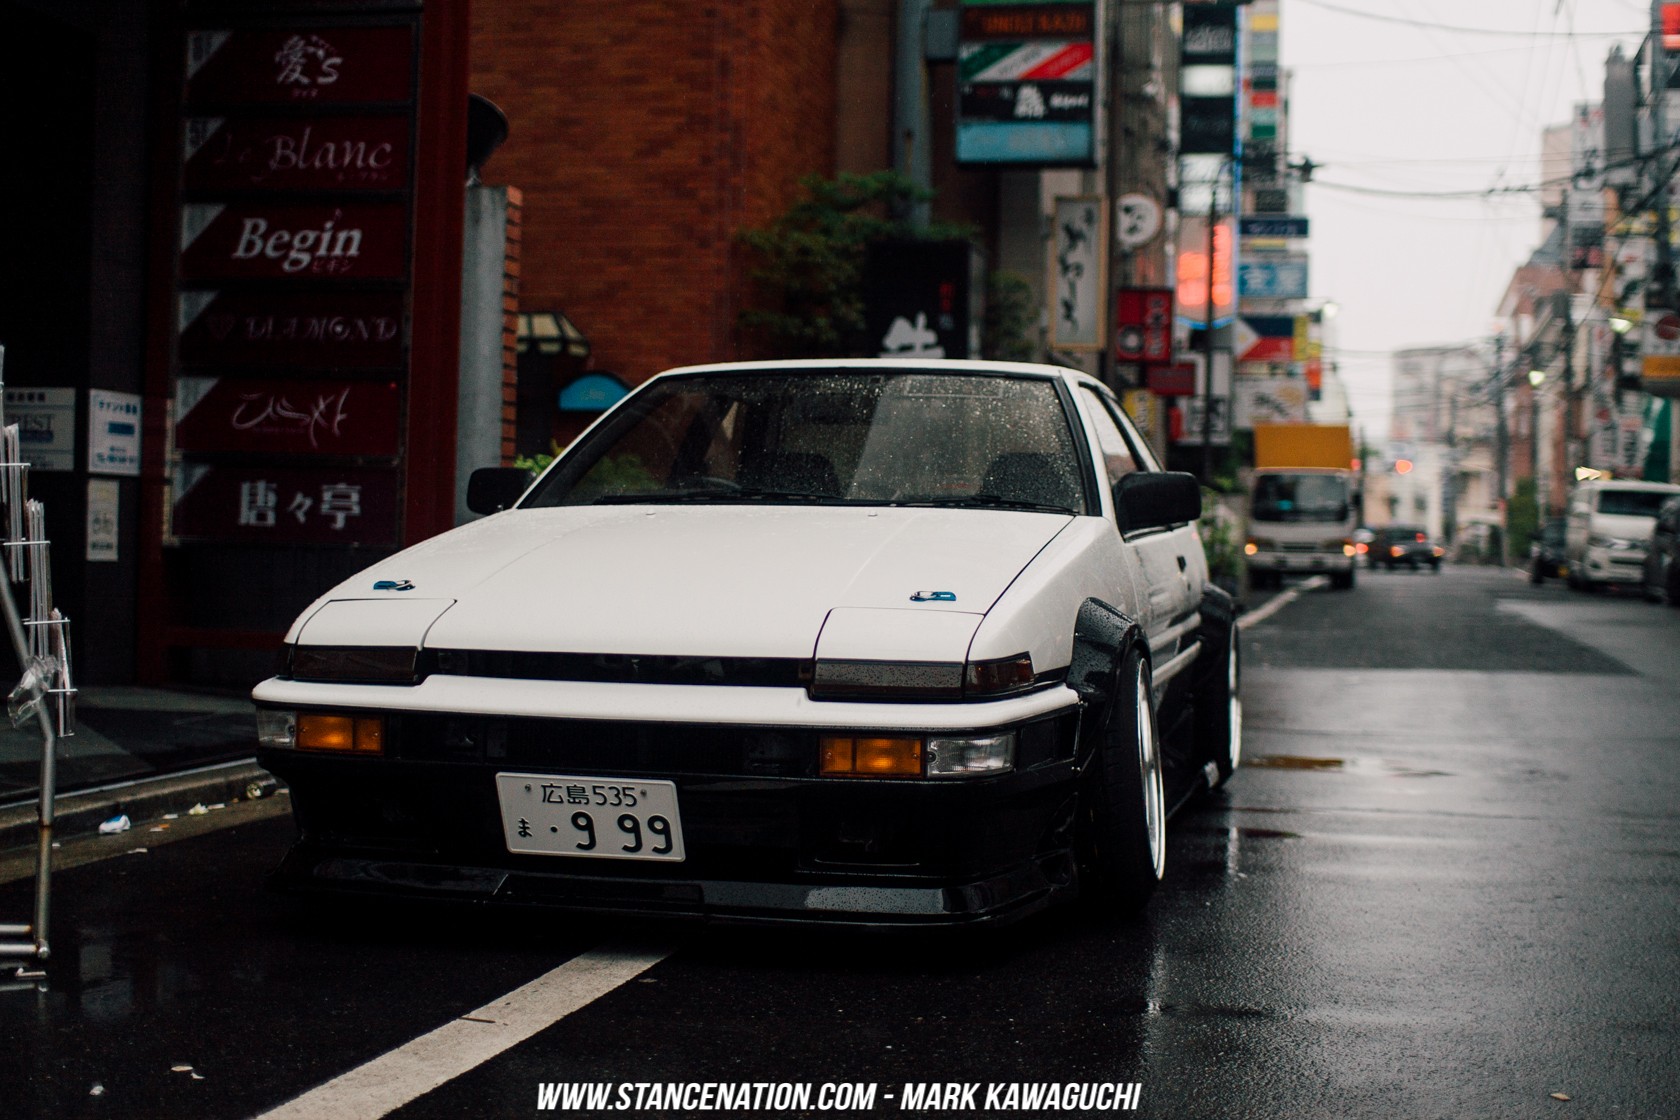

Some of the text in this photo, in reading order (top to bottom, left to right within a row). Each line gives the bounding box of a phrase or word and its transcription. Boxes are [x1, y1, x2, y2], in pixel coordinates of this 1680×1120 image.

[265, 125, 393, 172] Blanc
[231, 216, 363, 273] Begin
[244, 315, 398, 342] DIAMOND
[518, 818, 533, 838] ま
